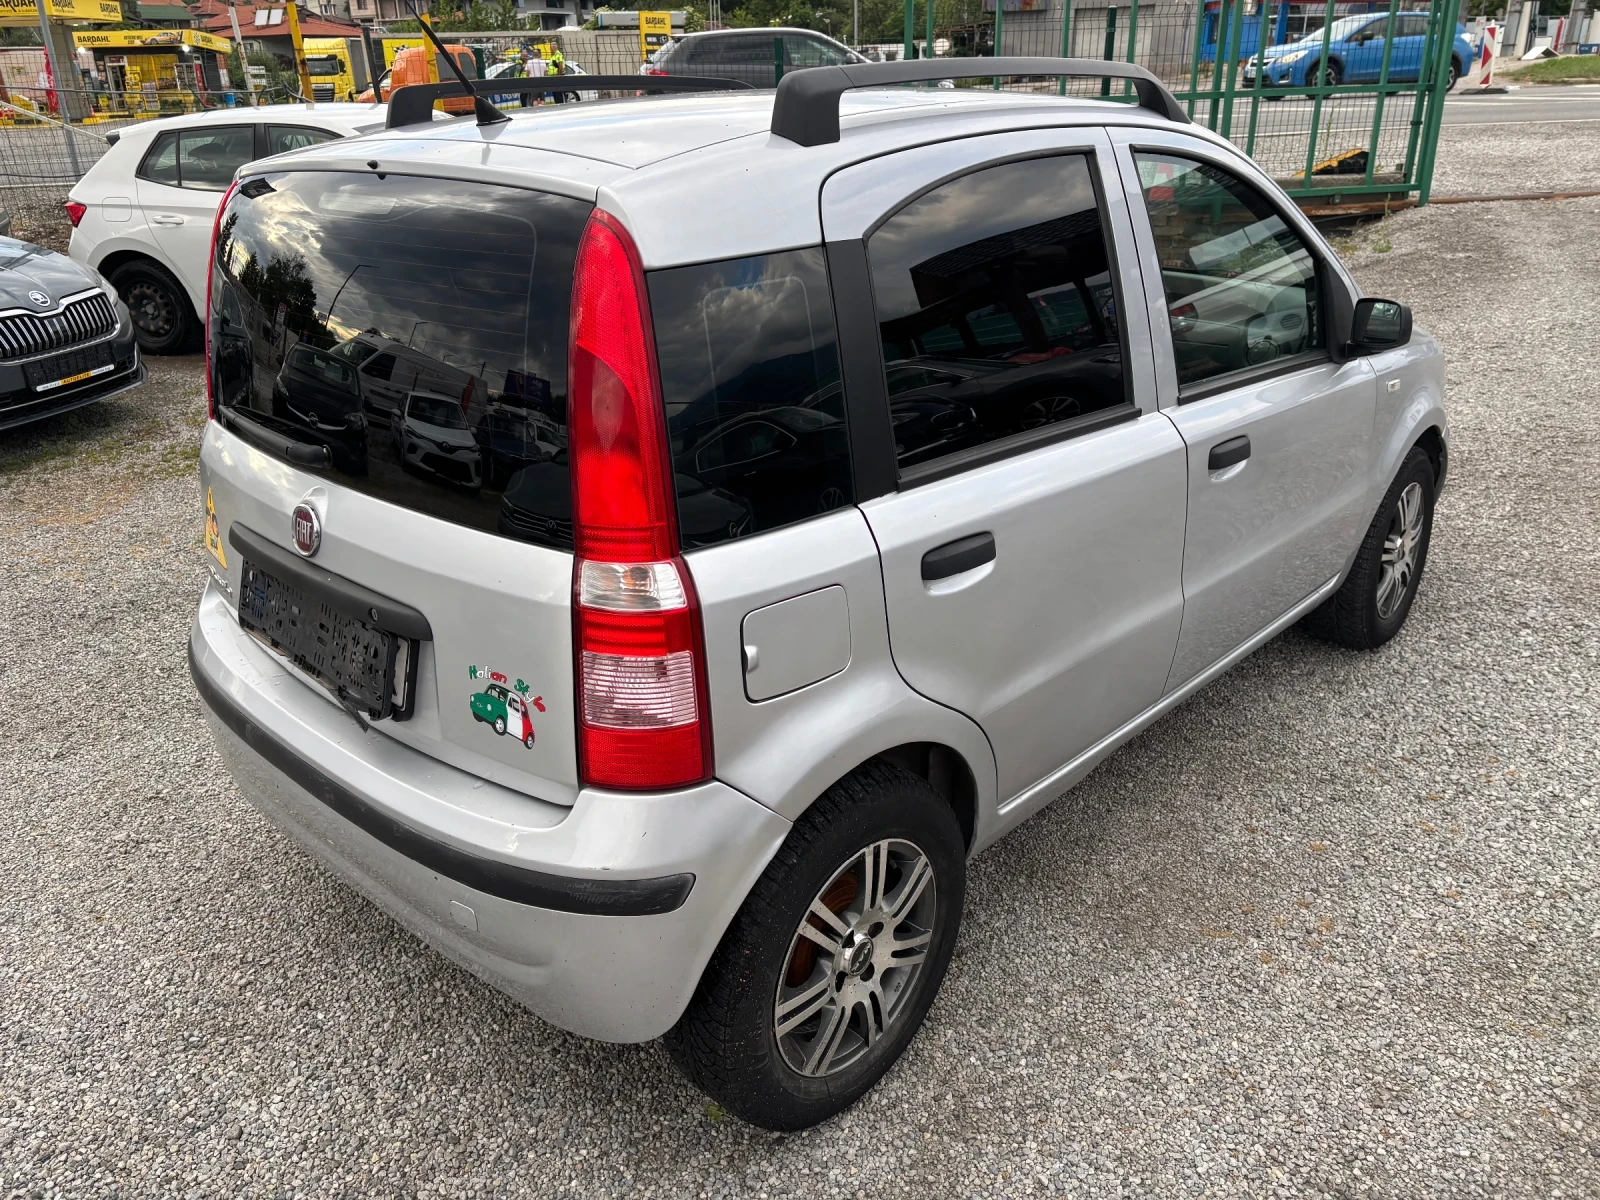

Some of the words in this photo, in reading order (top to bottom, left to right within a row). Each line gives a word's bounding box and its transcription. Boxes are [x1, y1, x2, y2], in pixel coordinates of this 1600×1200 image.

[77, 35, 110, 45] BARDAHL
[63, 372, 90, 384] AUTOELITE
[296, 517, 312, 545] FIAT
[468, 664, 508, 684] Italian
